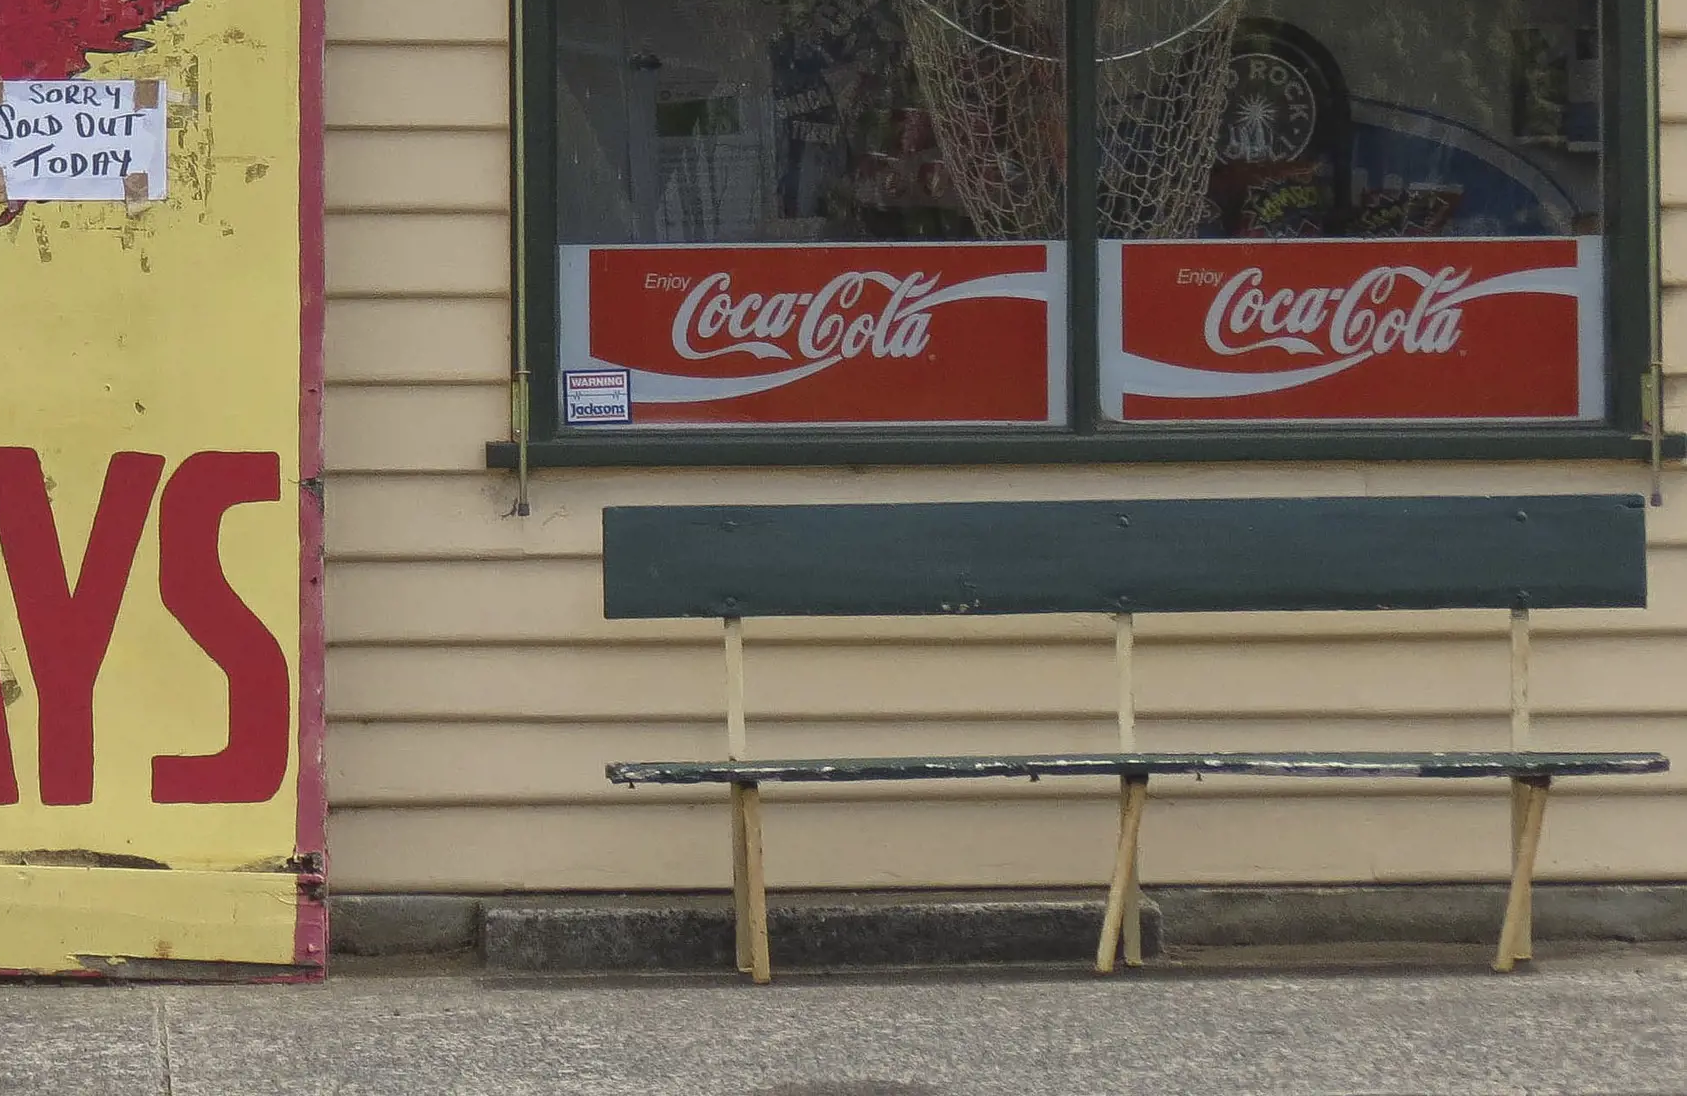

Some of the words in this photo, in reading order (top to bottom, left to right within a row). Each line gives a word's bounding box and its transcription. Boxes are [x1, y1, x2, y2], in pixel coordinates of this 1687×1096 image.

[28, 82, 121, 110] SORRY
[75, 111, 146, 138] OUT
[12, 143, 133, 178] TODAY
[644, 271, 691, 293] Enjoy
[671, 269, 943, 361] Coca-Cola
[1176, 267, 1224, 288] Enjoy
[1204, 265, 1473, 356] Coca-Cola
[570, 376, 623, 388] WARNING
[570, 403, 625, 418] Jacksons
